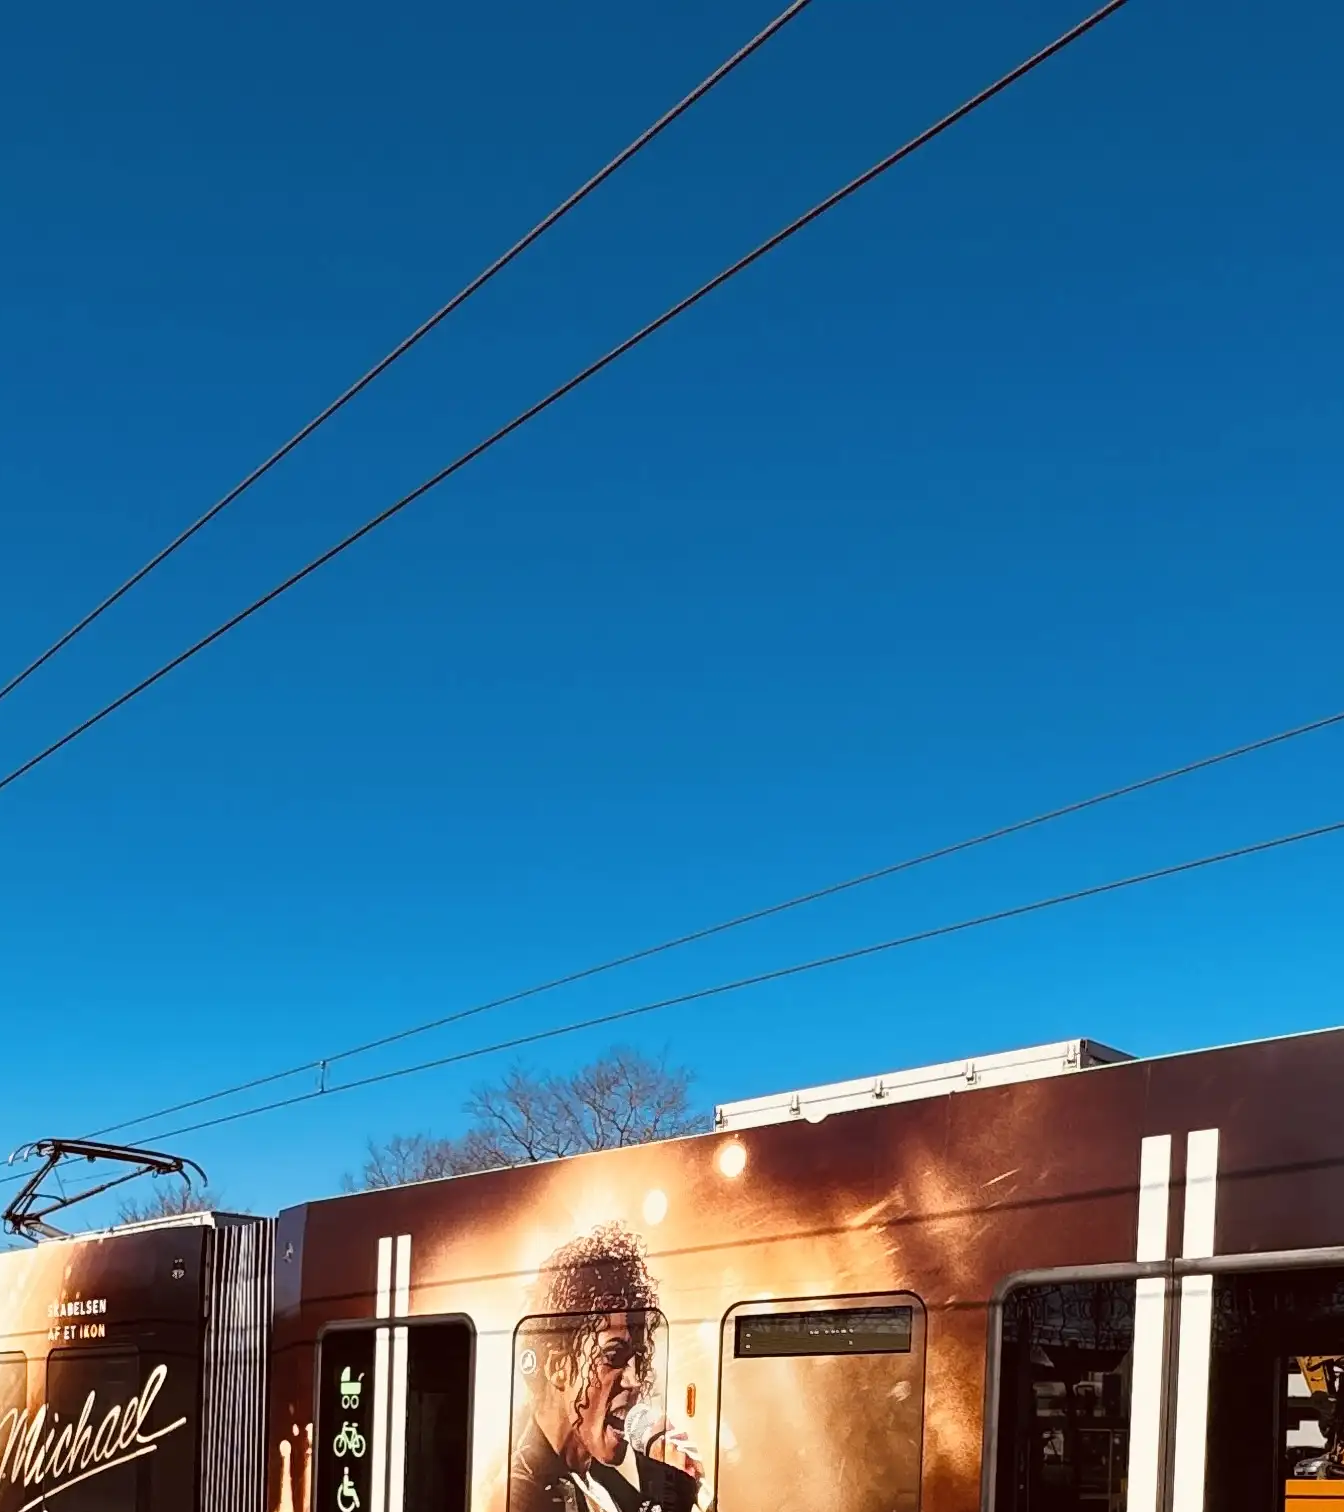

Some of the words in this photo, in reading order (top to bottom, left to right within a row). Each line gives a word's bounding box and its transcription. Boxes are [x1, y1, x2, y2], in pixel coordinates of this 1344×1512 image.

[47, 1299, 107, 1318] SKABELSEN
[47, 1328, 61, 1341] AF
[64, 1326, 76, 1340] ET
[79, 1323, 106, 1339] IKON
